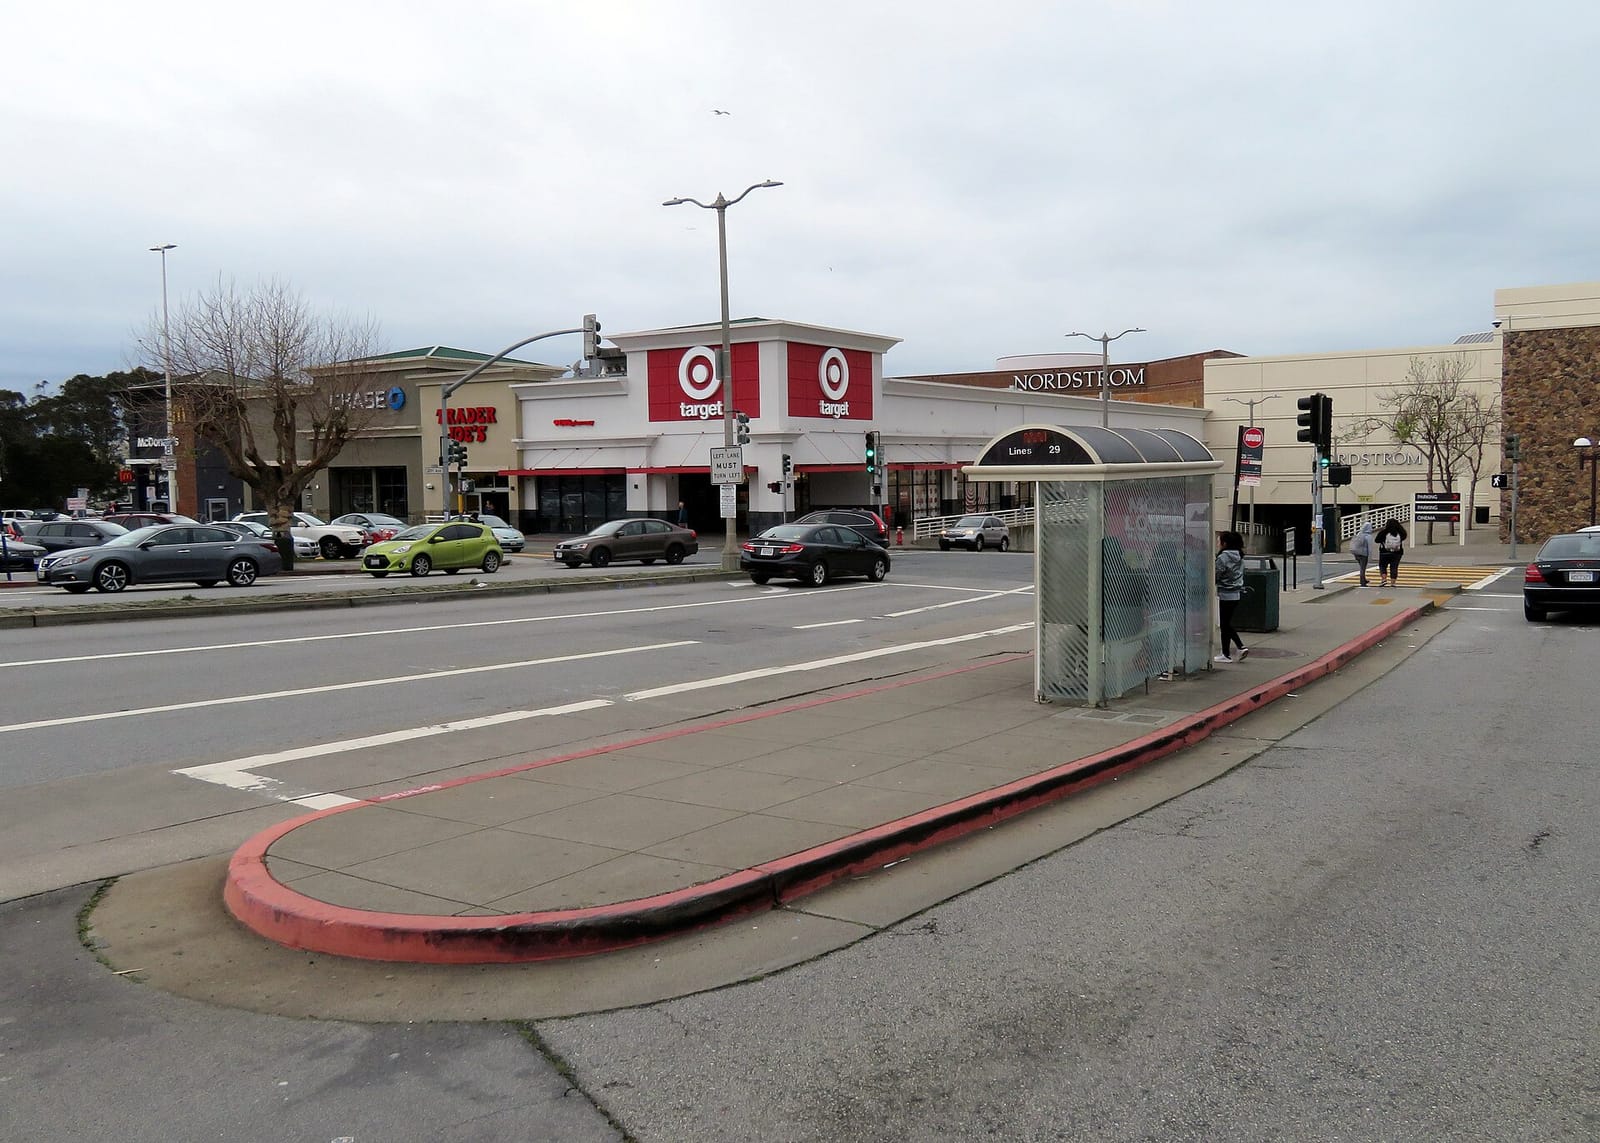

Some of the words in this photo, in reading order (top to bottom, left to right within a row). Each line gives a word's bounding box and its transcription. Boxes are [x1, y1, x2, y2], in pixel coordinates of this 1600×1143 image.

[1013, 367, 1145, 392] NORDSTROM
[436, 406, 498, 425] TRADER
[680, 400, 724, 420] target
[820, 400, 850, 419] target
[1008, 446, 1033, 456] Lines
[1048, 445, 1061, 454] 29
